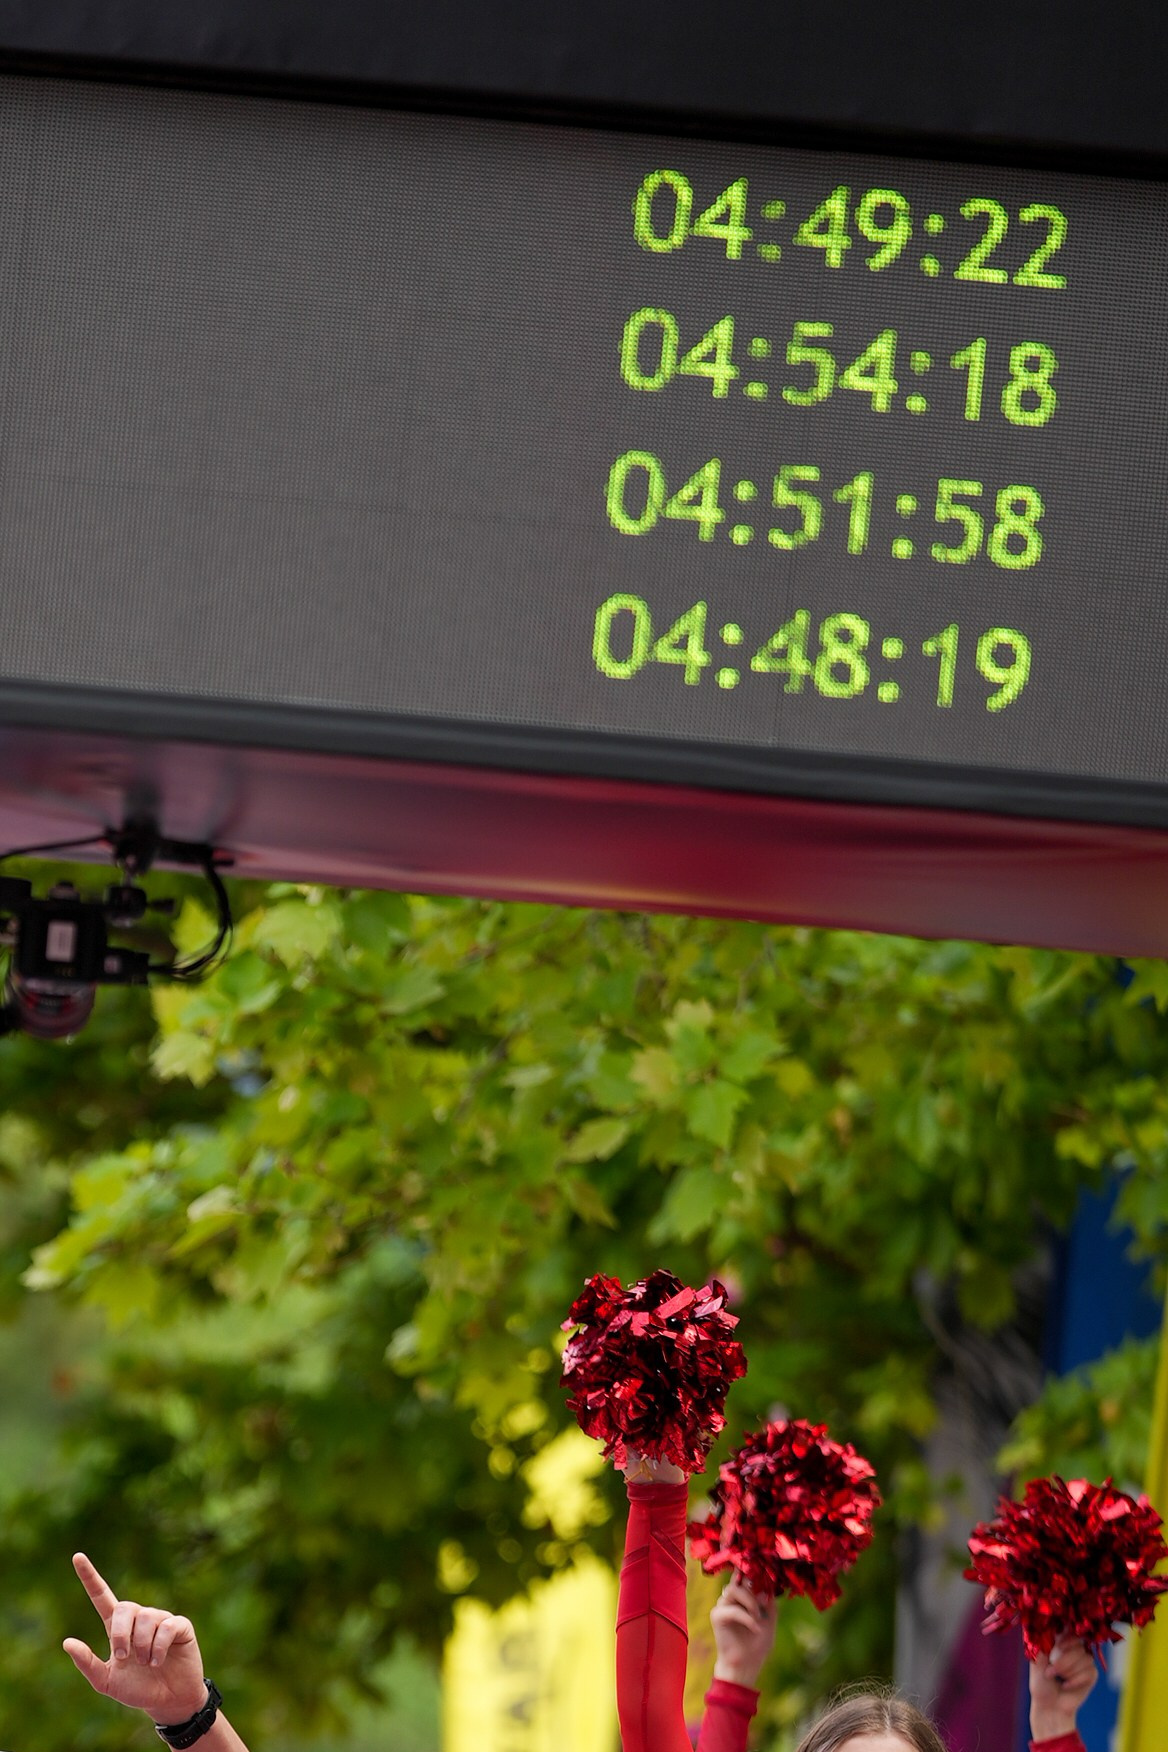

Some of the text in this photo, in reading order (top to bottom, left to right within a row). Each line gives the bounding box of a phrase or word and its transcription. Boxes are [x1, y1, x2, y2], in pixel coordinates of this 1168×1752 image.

[633, 170, 1068, 289] 04:49:22
[620, 307, 1058, 426] 04:54:18
[606, 450, 1045, 570] 04:51:58
[592, 593, 1032, 712] 04:48:19
